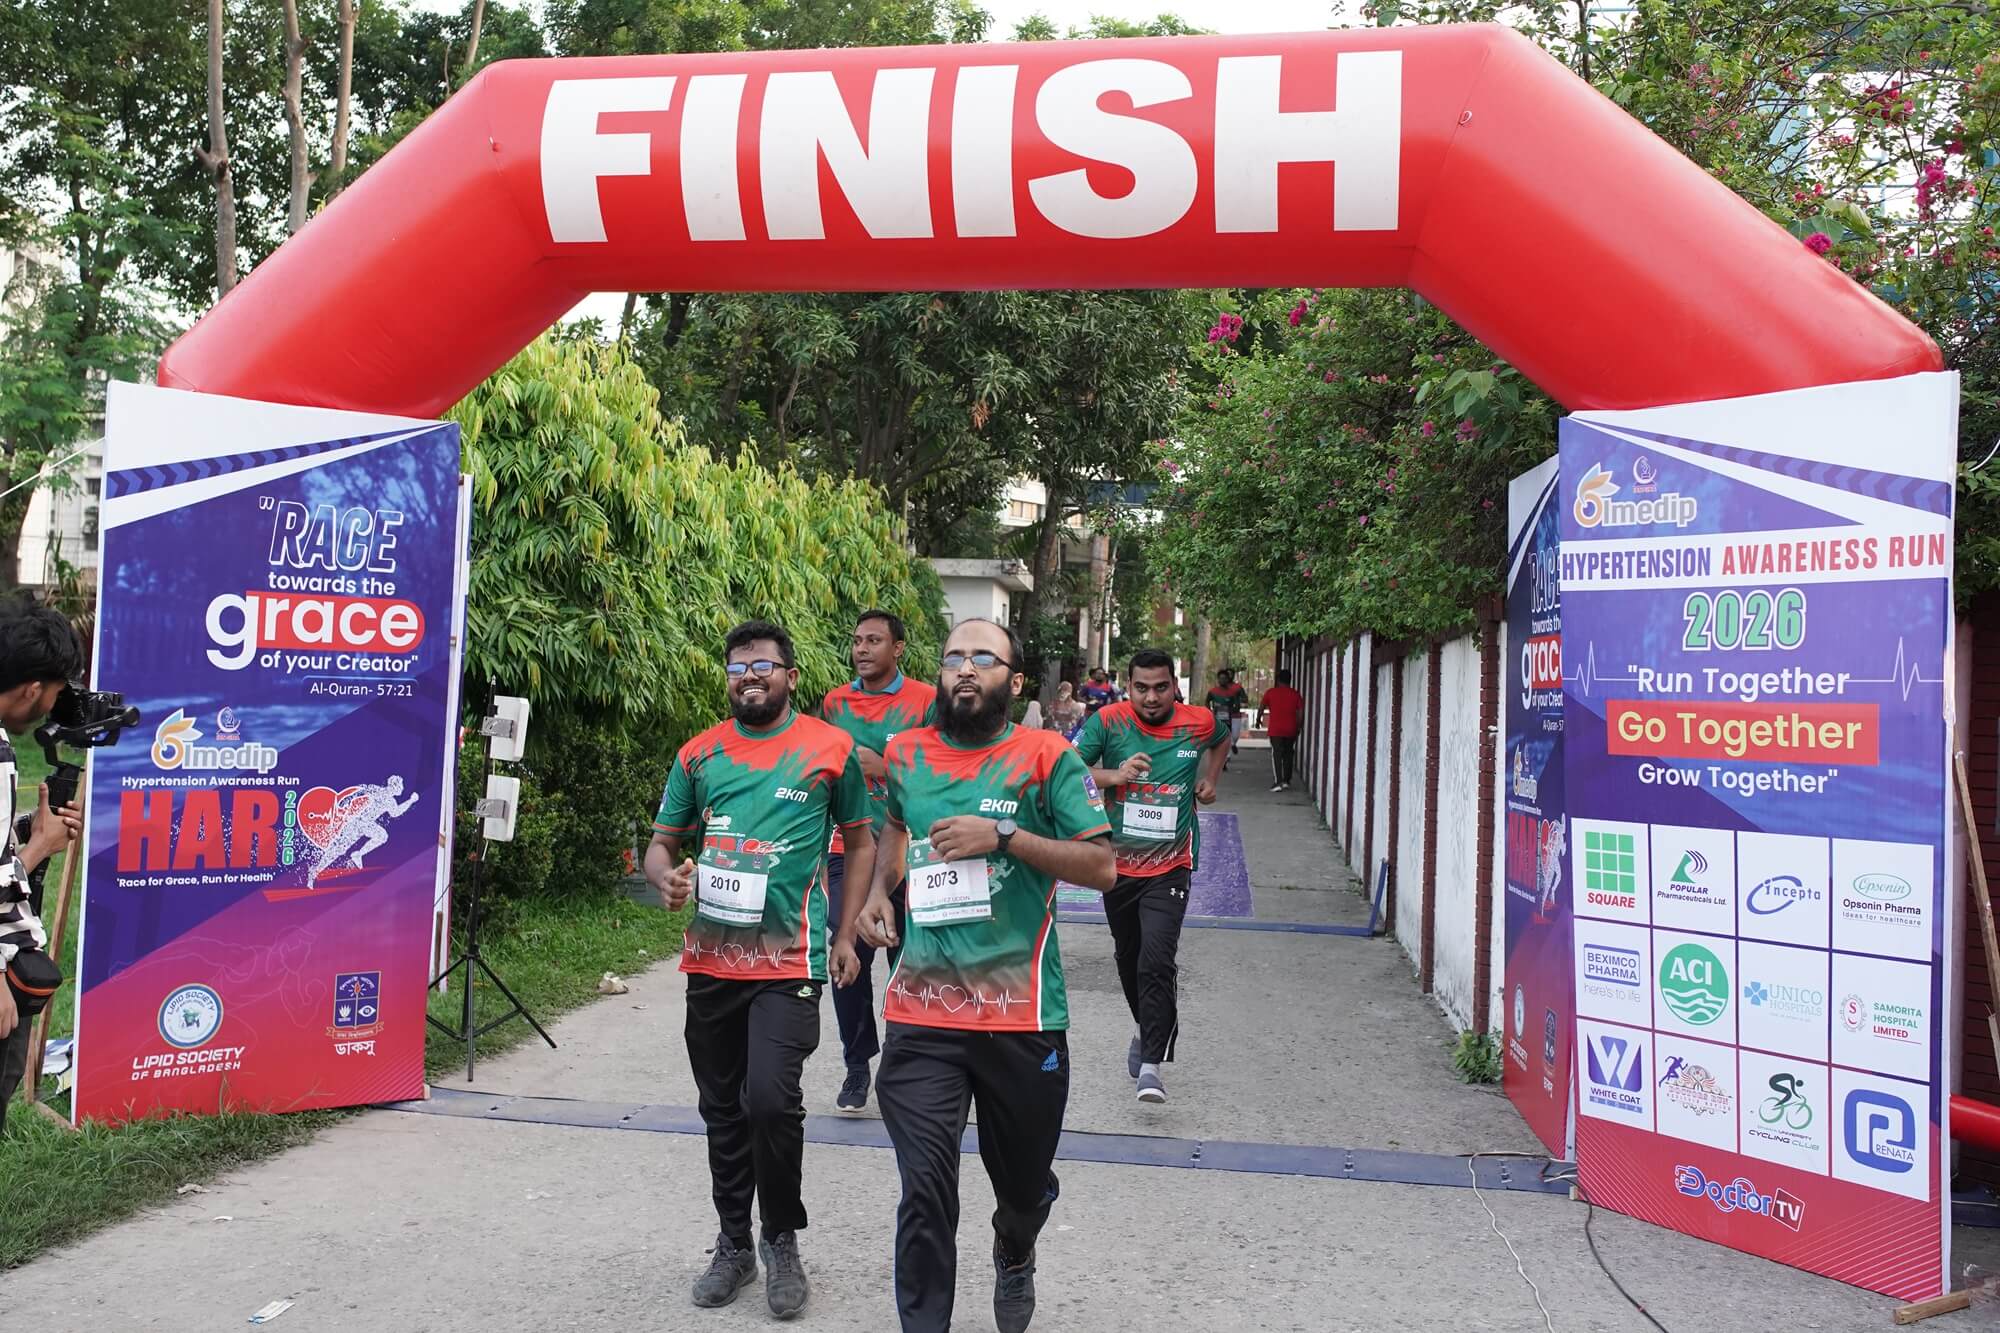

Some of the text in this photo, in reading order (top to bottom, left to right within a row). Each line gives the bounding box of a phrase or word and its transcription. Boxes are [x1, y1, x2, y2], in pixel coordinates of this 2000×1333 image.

[540, 50, 1402, 243] FINISH
[1562, 533, 1945, 581] HYPERTENSION AWARENESS RUN
[269, 572, 395, 595] towards the
[1682, 588, 1807, 651] 2026
[205, 592, 419, 671] grace
[260, 652, 418, 674] of your Creator"
[1522, 638, 1562, 710] grac
[1628, 664, 1850, 702] "Run Together
[310, 682, 413, 697] Al-Quran- 57:21
[1618, 711, 1862, 758] Go Together
[1177, 750, 1198, 758] 2KM
[122, 776, 300, 789] Hypertension Awareness Run
[1638, 764, 1838, 797] Grow Together"
[774, 787, 808, 803] 2KM
[979, 798, 1018, 814] 2KM
[1138, 809, 1162, 820] 3009
[117, 790, 280, 872] HAR
[282, 790, 297, 866] 2026
[148, 876, 164, 886] for
[166, 876, 200, 886] Grace,
[202, 874, 222, 884] Run
[224, 873, 238, 883] for
[711, 875, 740, 892] 2010
[926, 870, 958, 890] 2073
[1657, 891, 1712, 904] Pharmaceuticals
[1670, 884, 1708, 894] POPULAR
[1765, 879, 1821, 901] incepta
[1587, 892, 1636, 909] SQUARE
[1843, 898, 1921, 914] Opsonin Pharma
[1588, 952, 1637, 968] BEXIMCO
[1588, 964, 1638, 981] PHARMA
[1669, 957, 1712, 986] ACI
[186, 991, 215, 1011] SOCIETY
[1616, 988, 1626, 998] to
[1769, 984, 1823, 1006] UNICO
[1770, 1000, 1822, 1016] HOSPITALS
[1874, 1002, 1922, 1018] SAMORITA
[1874, 1014, 1918, 1029] HOSPITAL
[1873, 1026, 1908, 1038] LIMITED
[334, 1040, 376, 1056] ডাকসু
[132, 1046, 246, 1069] LIPID SOCIETY
[132, 1060, 241, 1081] OF BANGLADESH
[1591, 1087, 1616, 1100] WHITE
[1620, 1094, 1641, 1105] COAT
[1748, 1130, 1790, 1144] CYCLING
[1875, 1144, 1915, 1162] RENATA
[1675, 1165, 1801, 1222] Doctor TV
